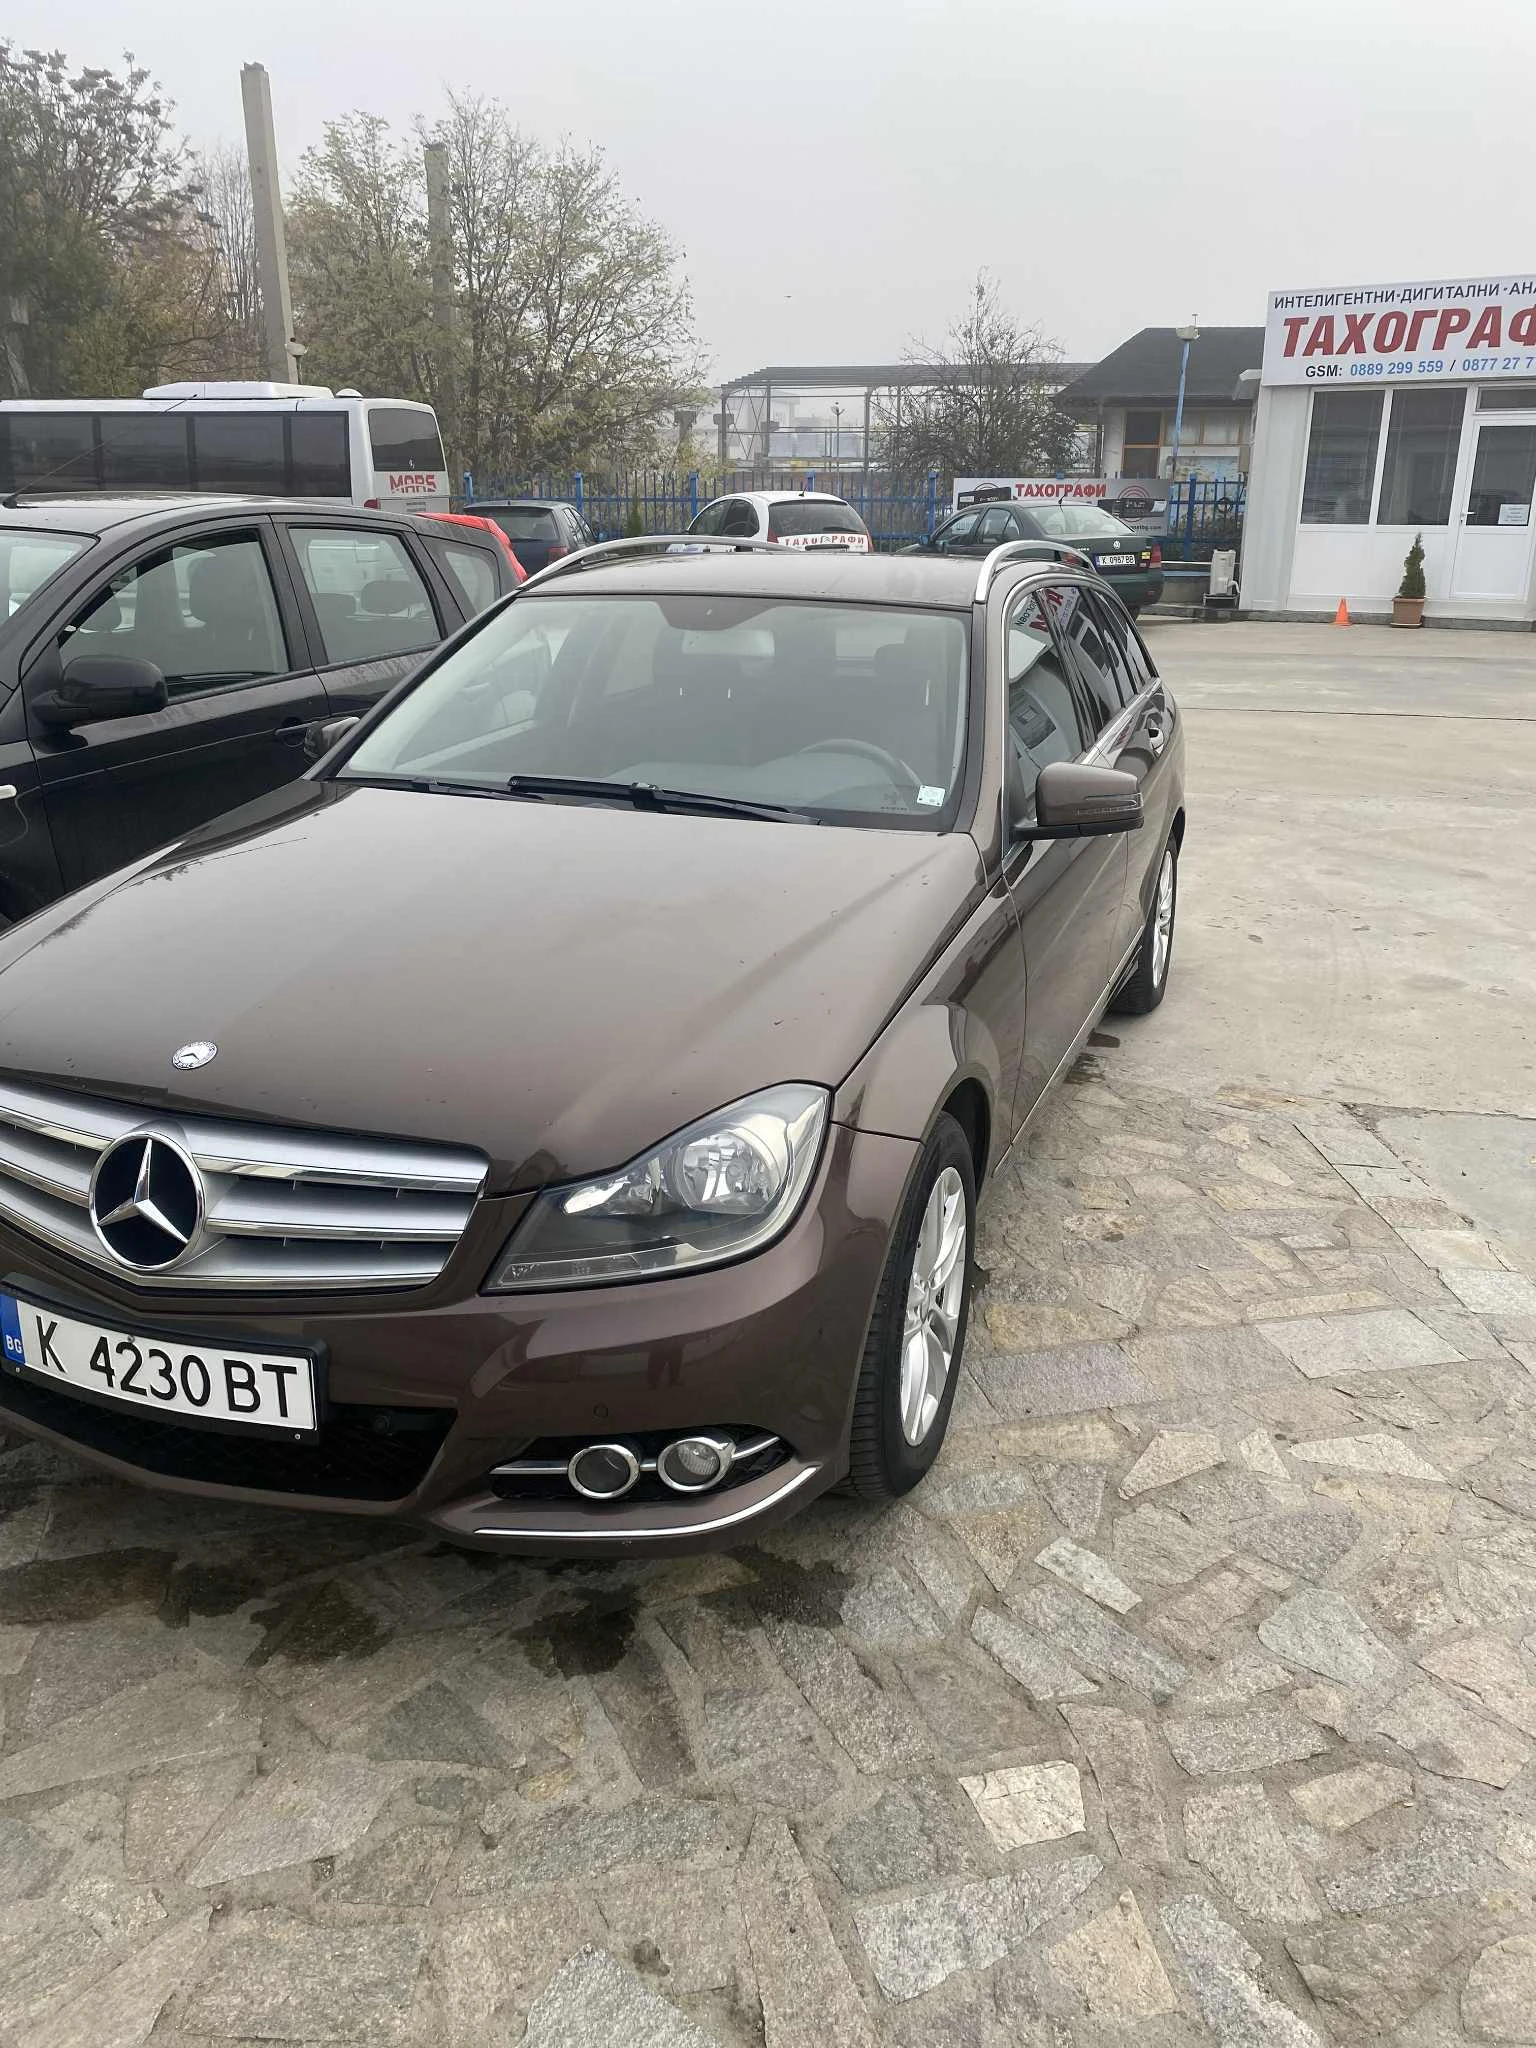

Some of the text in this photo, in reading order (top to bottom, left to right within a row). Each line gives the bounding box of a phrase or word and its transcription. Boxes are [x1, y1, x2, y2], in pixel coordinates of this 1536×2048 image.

[1305, 364, 1343, 378] GSM:
[1350, 362, 1383, 376] 0889
[1387, 361, 1413, 375] 299
[1418, 360, 1443, 373] 559
[1462, 358, 1498, 371] 0877
[1501, 357, 1520, 370] 27
[1526, 356, 1536, 369] 7
[389, 474, 437, 494] MARS
[1015, 483, 1107, 498] ТАХОГРАФИ
[784, 535, 864, 546] ТАХОГРАФИ
[6, 1334, 22, 1353] BG
[35, 1315, 297, 1417] K 4230 BT
